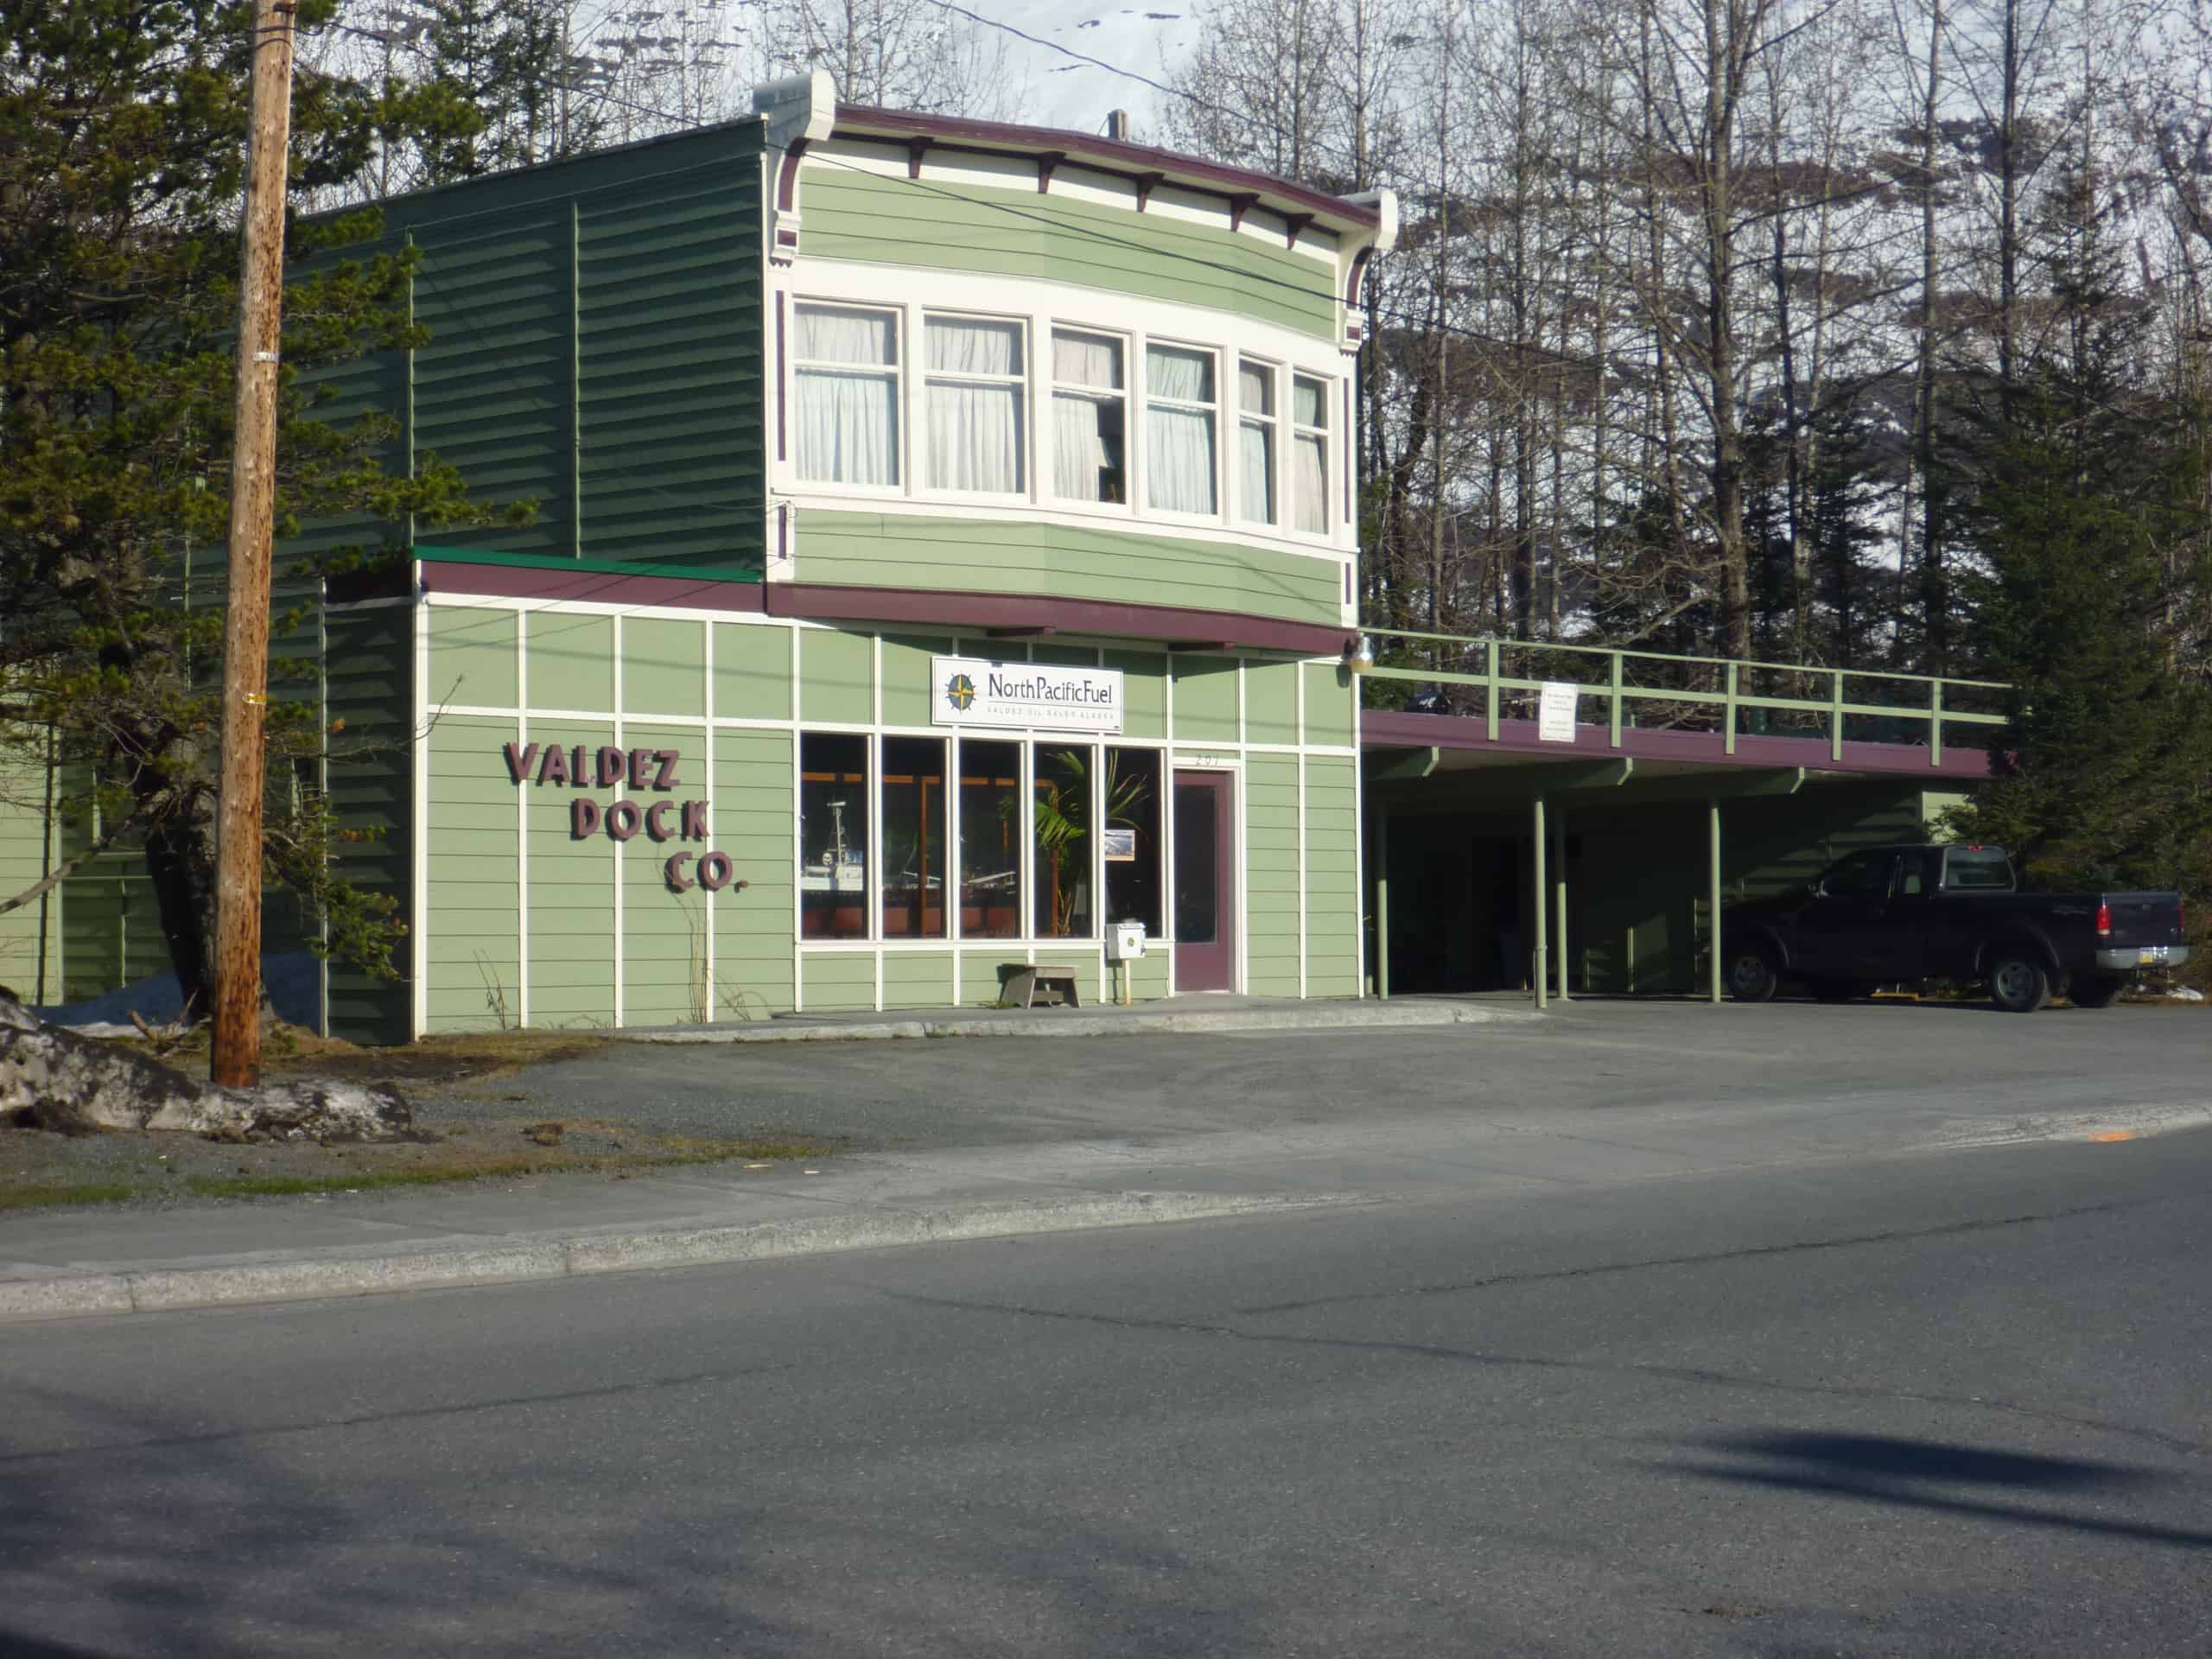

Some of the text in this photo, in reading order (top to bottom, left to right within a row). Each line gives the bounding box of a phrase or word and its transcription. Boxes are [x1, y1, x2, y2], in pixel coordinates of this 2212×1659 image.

[503, 743, 680, 790] VALDEZ
[572, 798, 710, 841] DOCK
[664, 851, 748, 893] CO.
